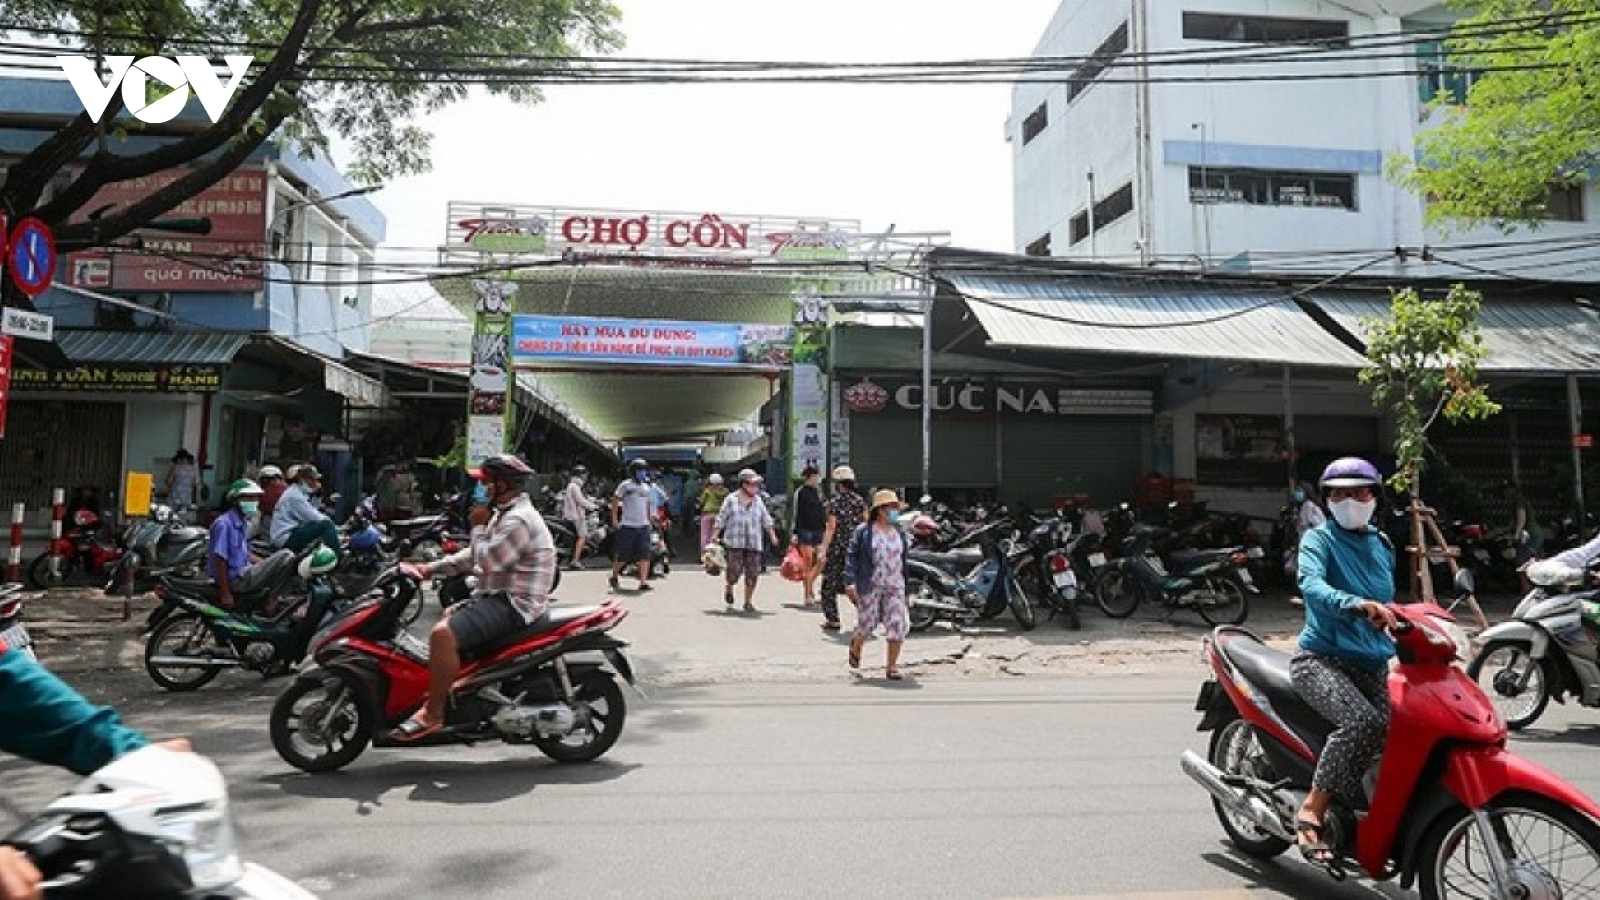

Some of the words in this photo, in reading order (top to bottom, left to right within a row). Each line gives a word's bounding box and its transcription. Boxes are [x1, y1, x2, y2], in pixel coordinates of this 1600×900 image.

[561, 214, 650, 251] CHỢ
[666, 213, 750, 248] CỒN
[996, 387, 1055, 413] NA
